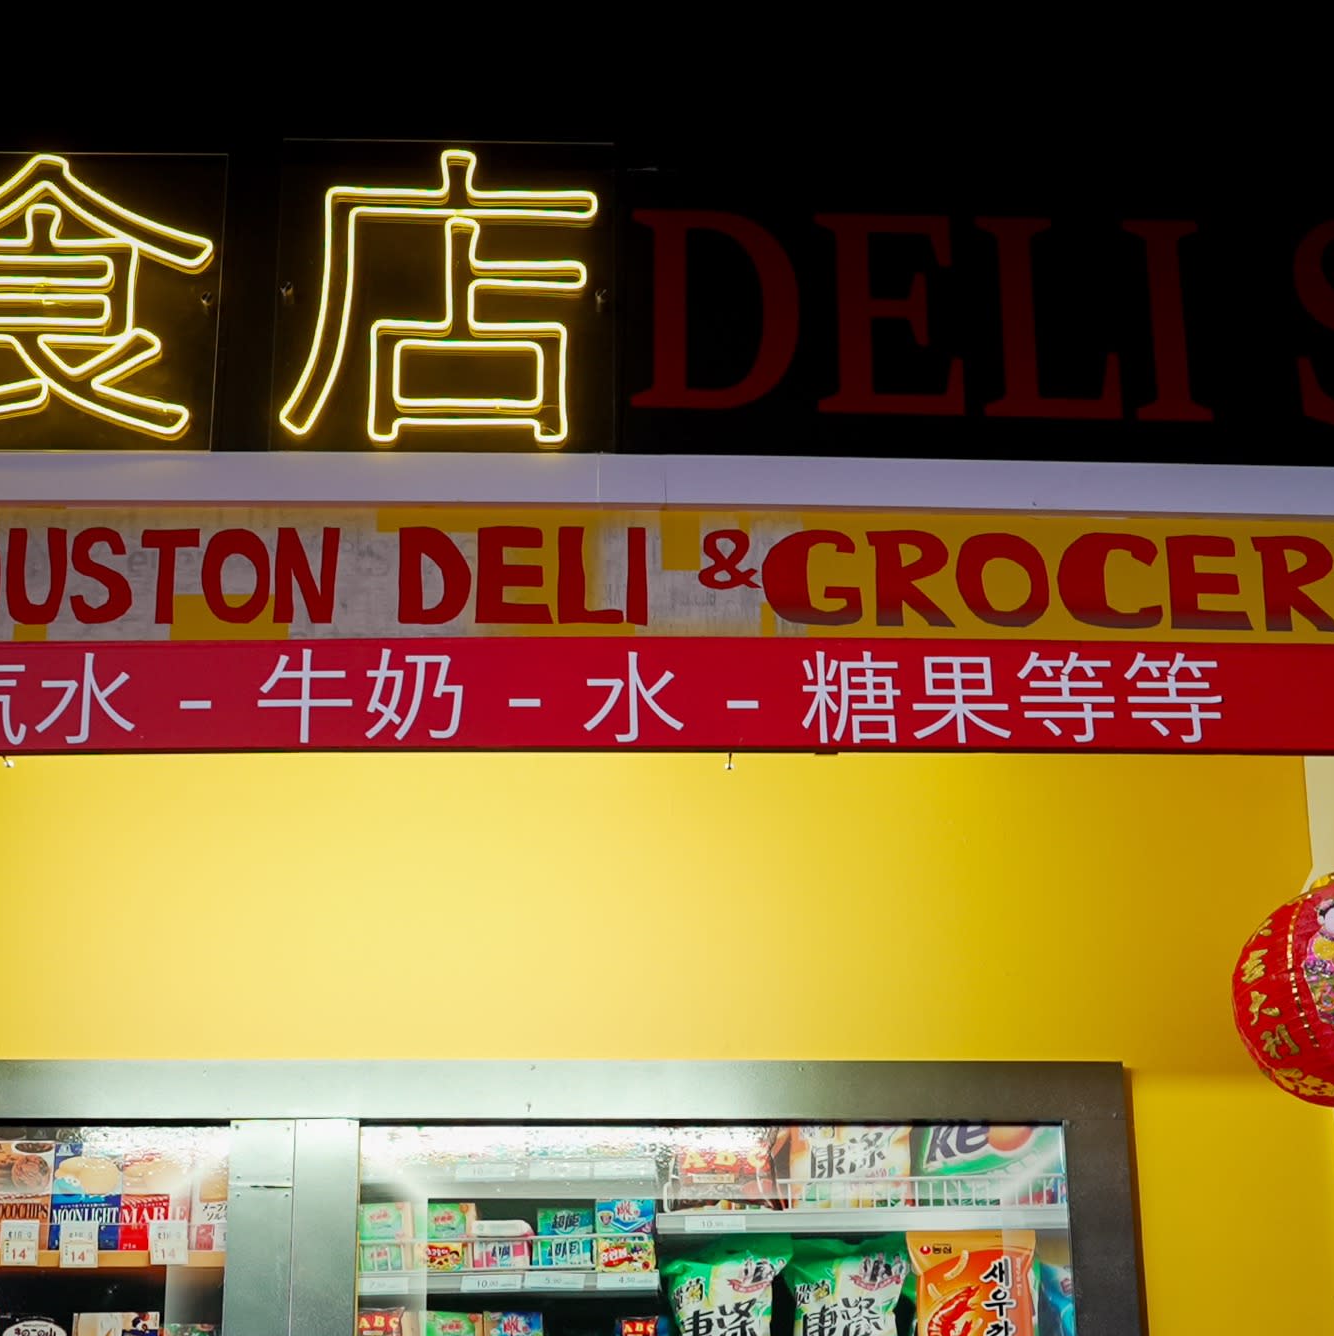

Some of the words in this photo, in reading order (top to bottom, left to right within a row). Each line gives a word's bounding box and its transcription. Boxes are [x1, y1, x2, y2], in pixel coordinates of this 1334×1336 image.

[632, 207, 1215, 424] DELI
[398, 525, 647, 625] DELI
[257, 650, 464, 744] 牛奶
[583, 652, 684, 744] 水
[801, 652, 1221, 744] 糖果等等
[51, 1206, 119, 1224] MOONLIGHT
